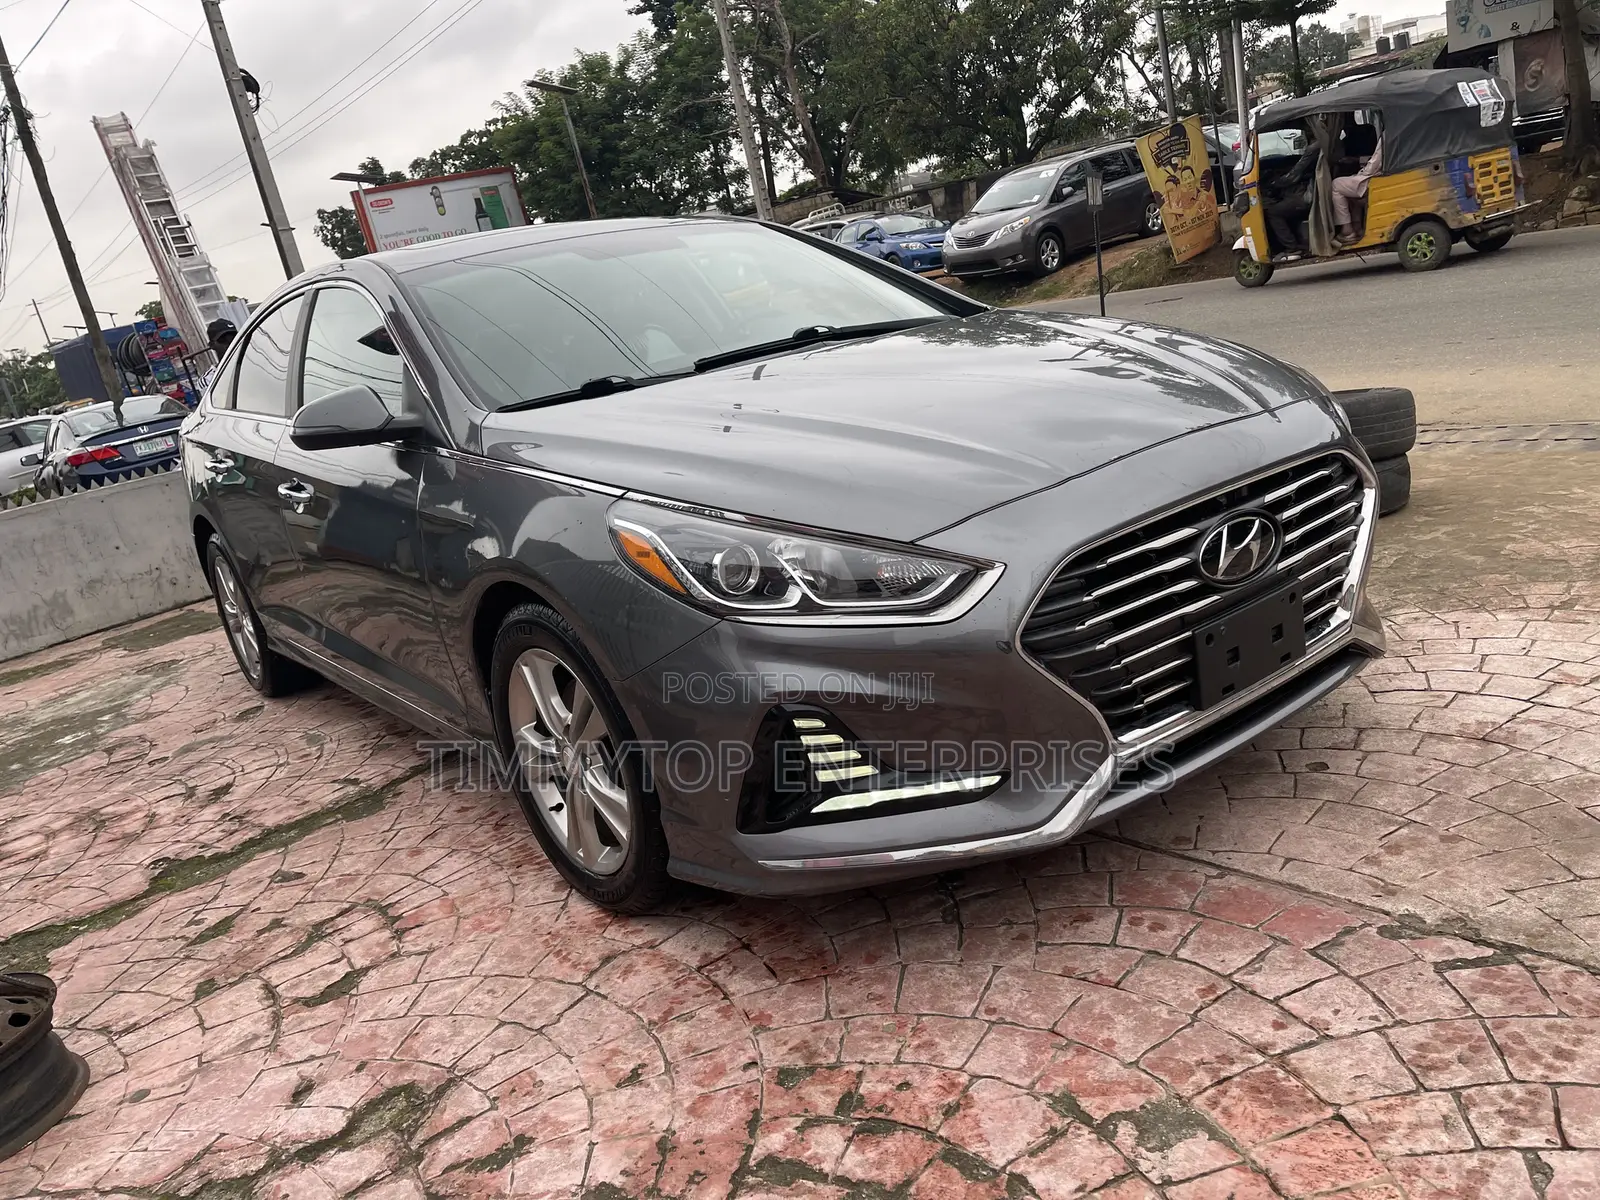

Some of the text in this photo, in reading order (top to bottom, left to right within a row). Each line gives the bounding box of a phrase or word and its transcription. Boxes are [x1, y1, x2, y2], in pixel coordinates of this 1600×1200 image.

[888, 195, 912, 210] KEEP
[383, 237, 415, 250] YOU'RE
[416, 232, 440, 243] GOOD
[442, 231, 453, 239] TO
